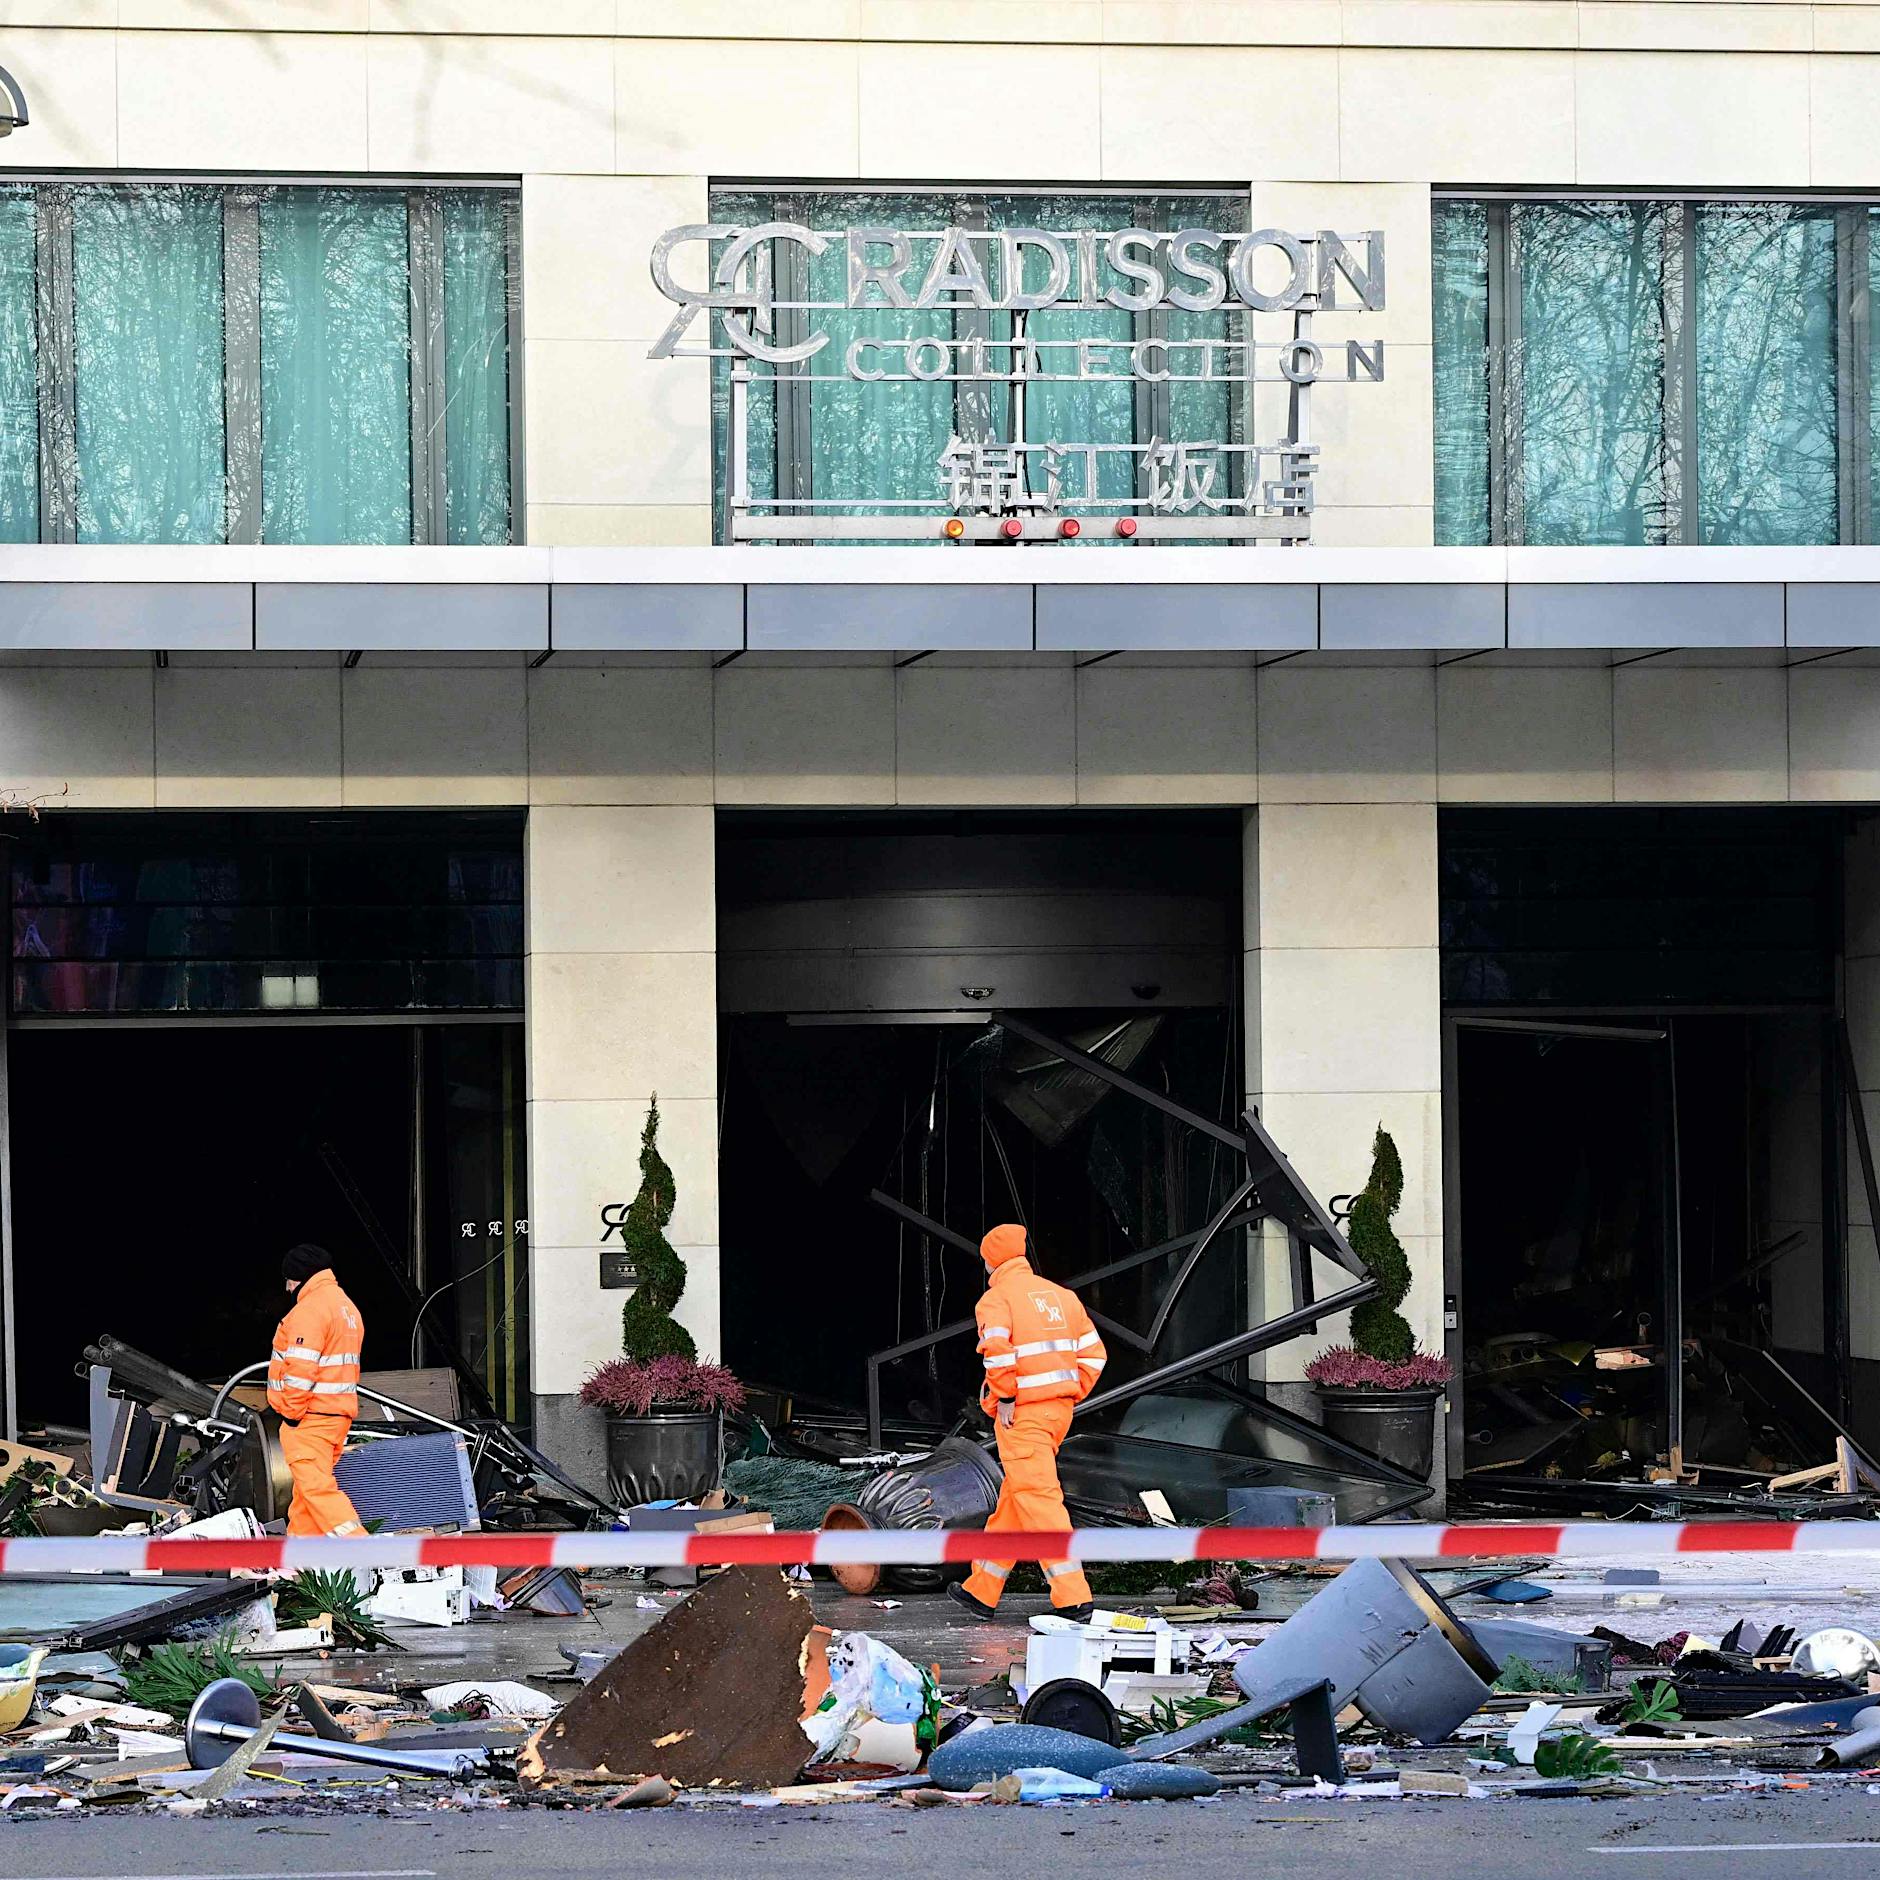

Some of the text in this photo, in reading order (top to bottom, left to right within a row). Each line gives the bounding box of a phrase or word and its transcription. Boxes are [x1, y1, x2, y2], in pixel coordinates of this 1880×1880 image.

[845, 228, 1386, 313] RADISSON
[846, 337, 1385, 382] COLLECTION
[936, 434, 1321, 516] 锦江饭店
